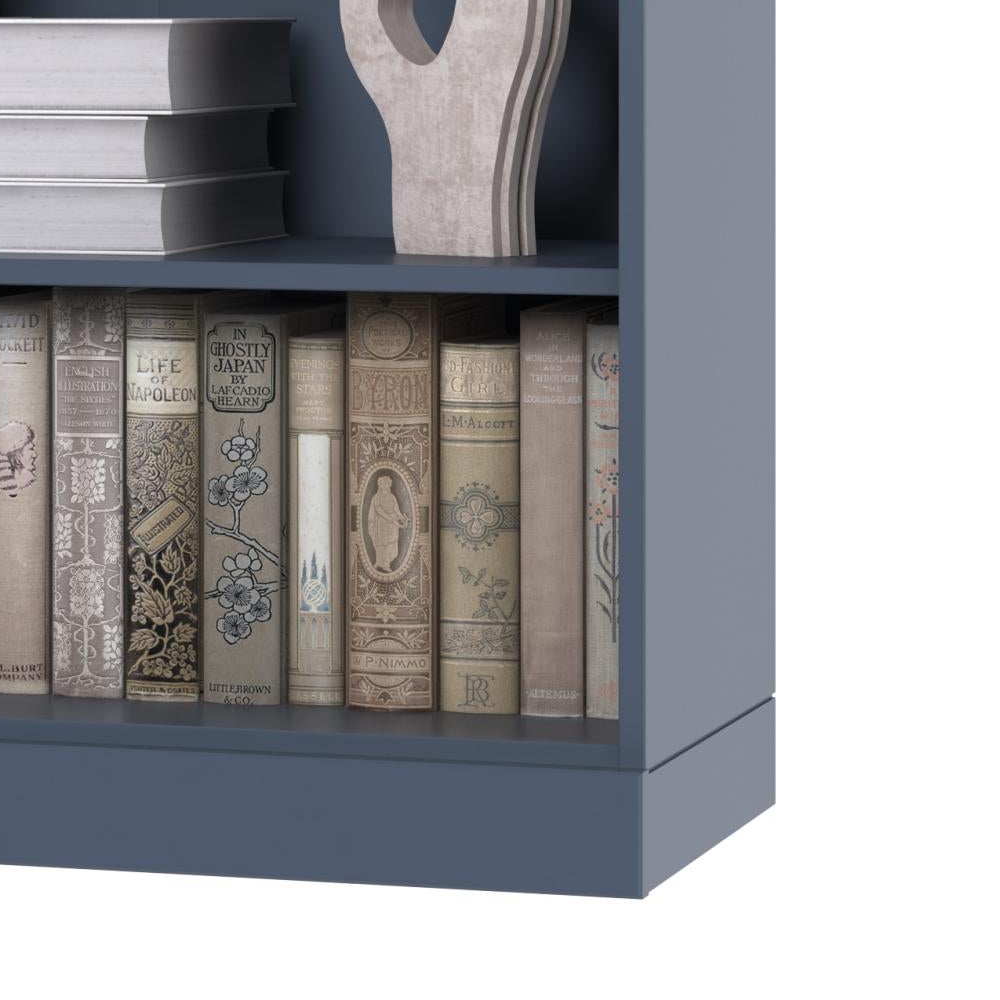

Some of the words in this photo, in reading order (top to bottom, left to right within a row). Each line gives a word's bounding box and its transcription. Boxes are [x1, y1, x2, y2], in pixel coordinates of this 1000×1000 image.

[233, 328, 247, 340] IN
[535, 331, 571, 342] ALICE
[210, 342, 272, 358] GHOSTLY
[136, 356, 182, 374] LIFE
[213, 359, 266, 374] JAPAN
[64, 365, 109, 377] ENGLISH
[151, 375, 169, 385] OF
[231, 375, 248, 385] BY
[529, 374, 579, 383] THROUGH
[127, 382, 198, 403] NAPOLEON
[211, 385, 271, 396] LAFCADIO
[296, 383, 332, 394] STARS
[352, 370, 428, 411] BYRON
[217, 396, 261, 407] HEARN
[224, 695, 232, 705] &
